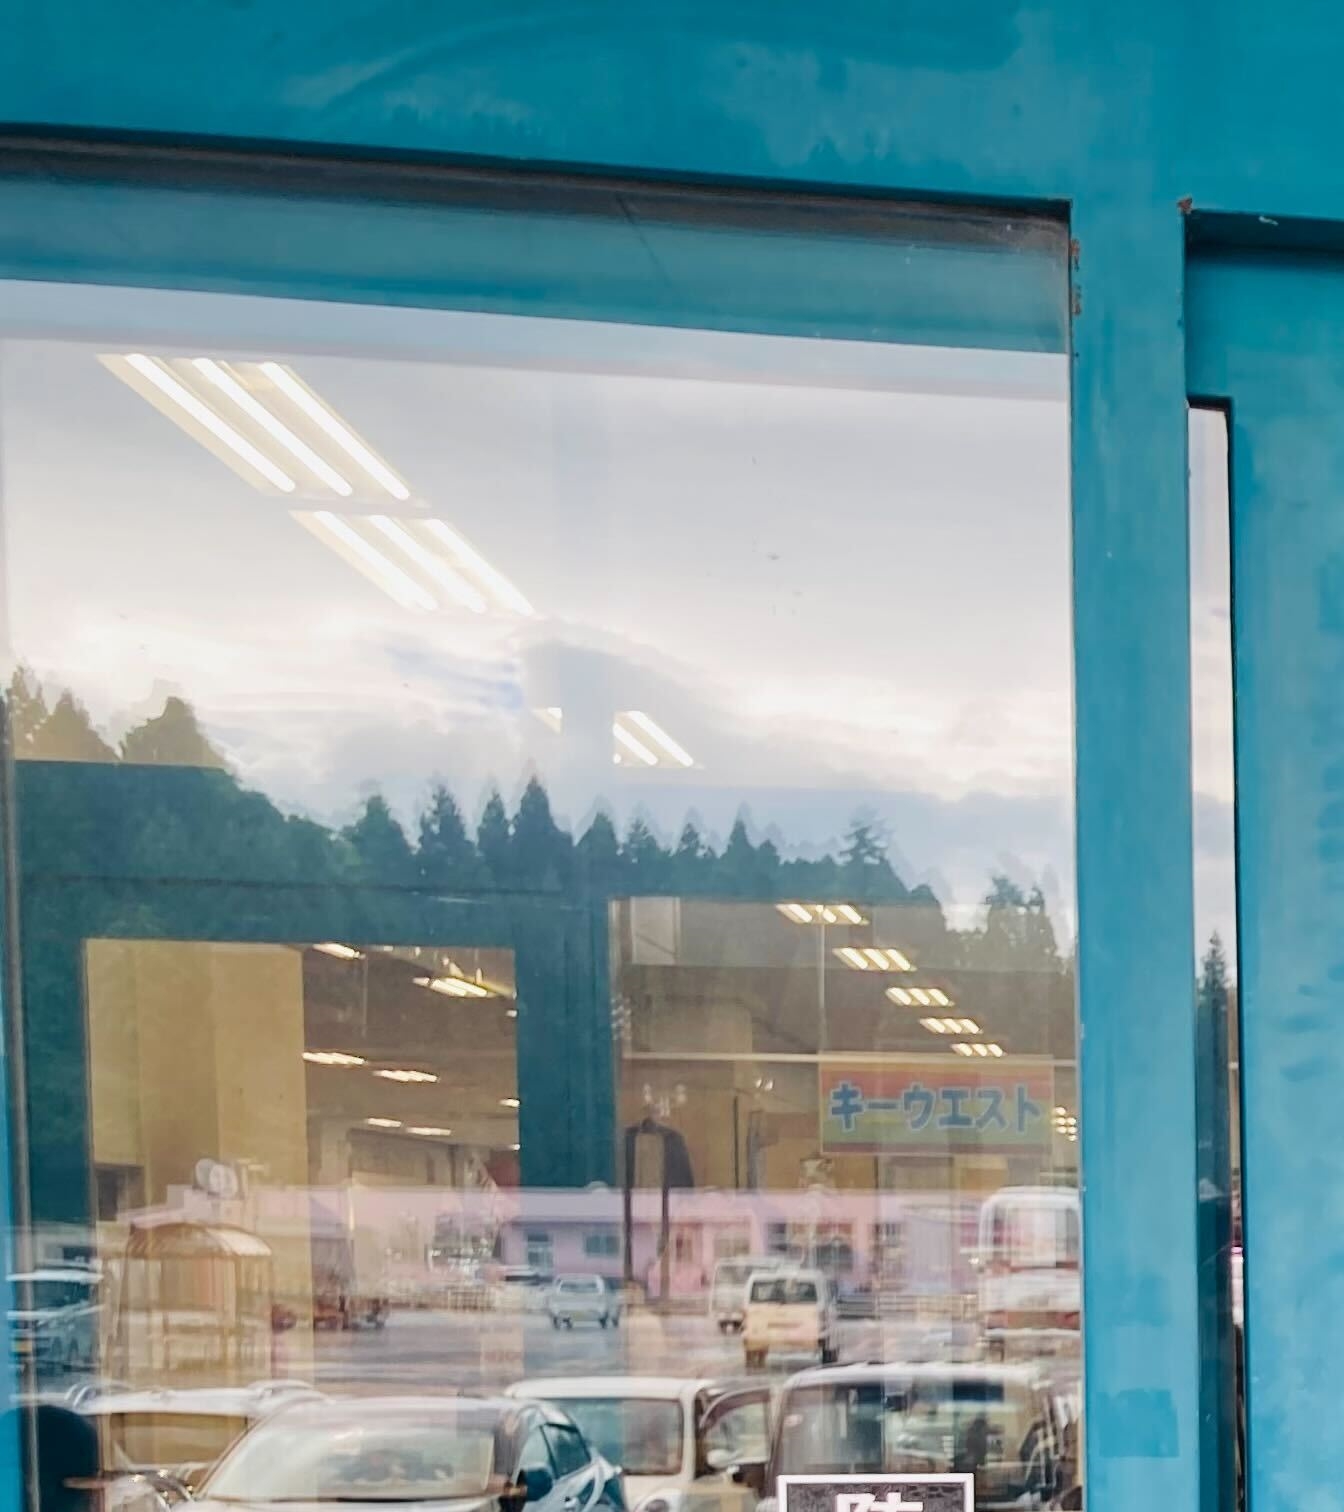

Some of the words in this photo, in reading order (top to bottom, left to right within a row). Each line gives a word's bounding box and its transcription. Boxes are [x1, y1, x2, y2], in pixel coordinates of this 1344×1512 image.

[831, 1081, 1042, 1134] キーウエスト
